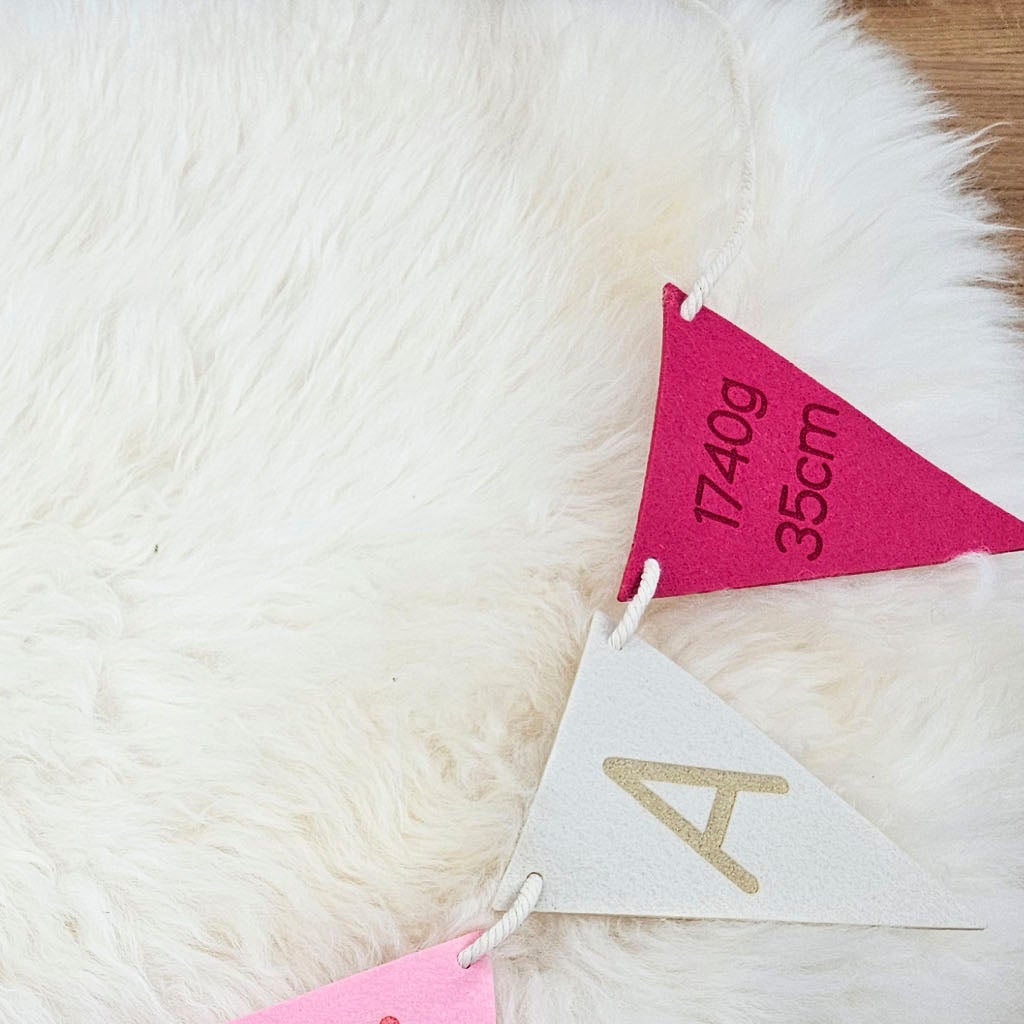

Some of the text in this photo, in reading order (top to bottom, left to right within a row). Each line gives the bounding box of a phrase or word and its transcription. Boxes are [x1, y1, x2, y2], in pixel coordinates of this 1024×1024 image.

[694, 377, 768, 528] 1740g
[775, 403, 840, 561] 35cm
[602, 757, 790, 894] A
